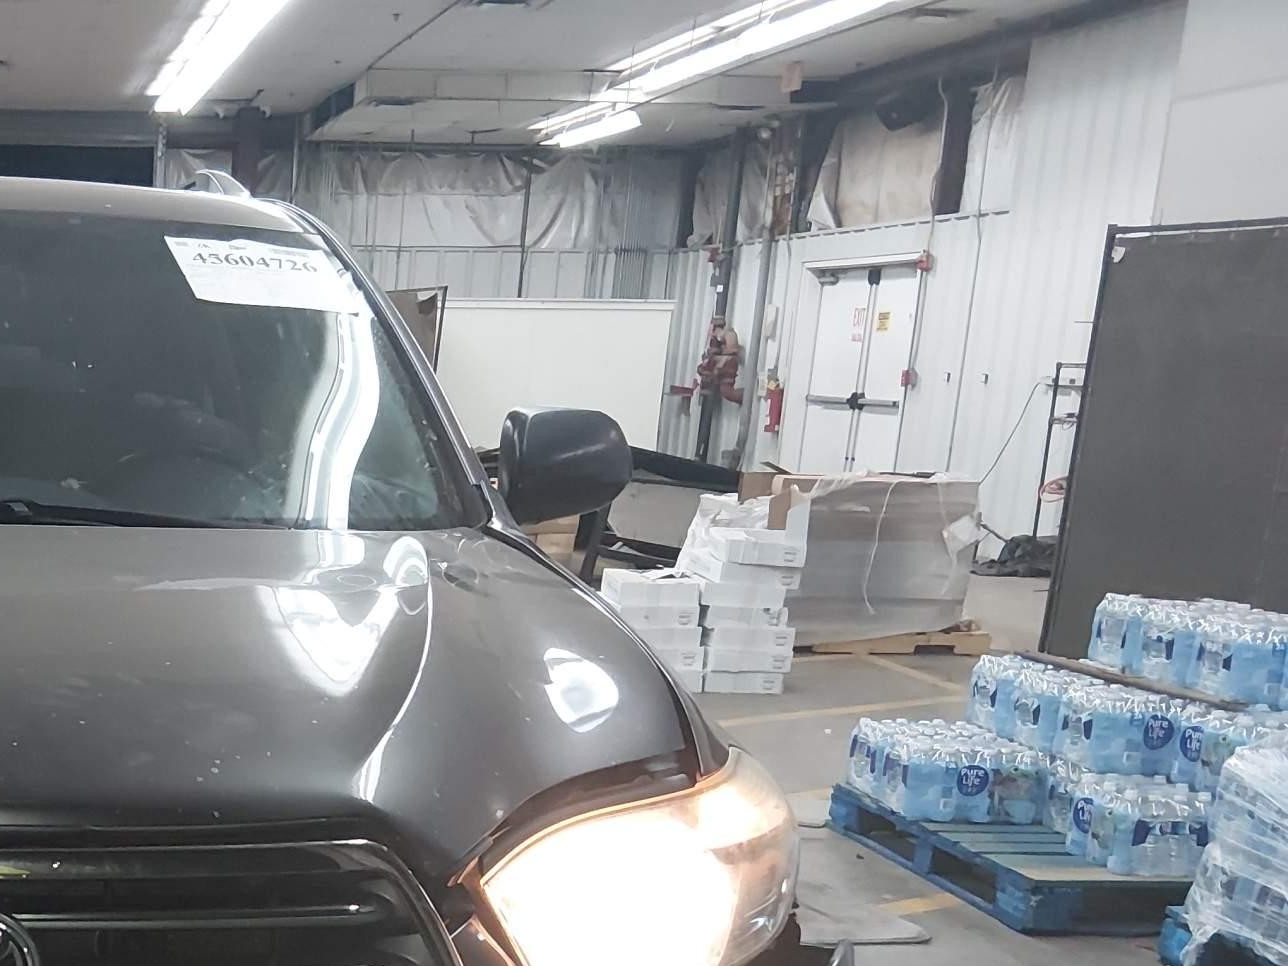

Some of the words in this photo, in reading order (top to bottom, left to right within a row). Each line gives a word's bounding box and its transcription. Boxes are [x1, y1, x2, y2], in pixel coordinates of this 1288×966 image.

[192, 252, 318, 273] 45604726
[1148, 719, 1169, 729] Pure
[1148, 727, 1165, 739] Life
[961, 768, 985, 777] Pure
[962, 775, 981, 787] Life
